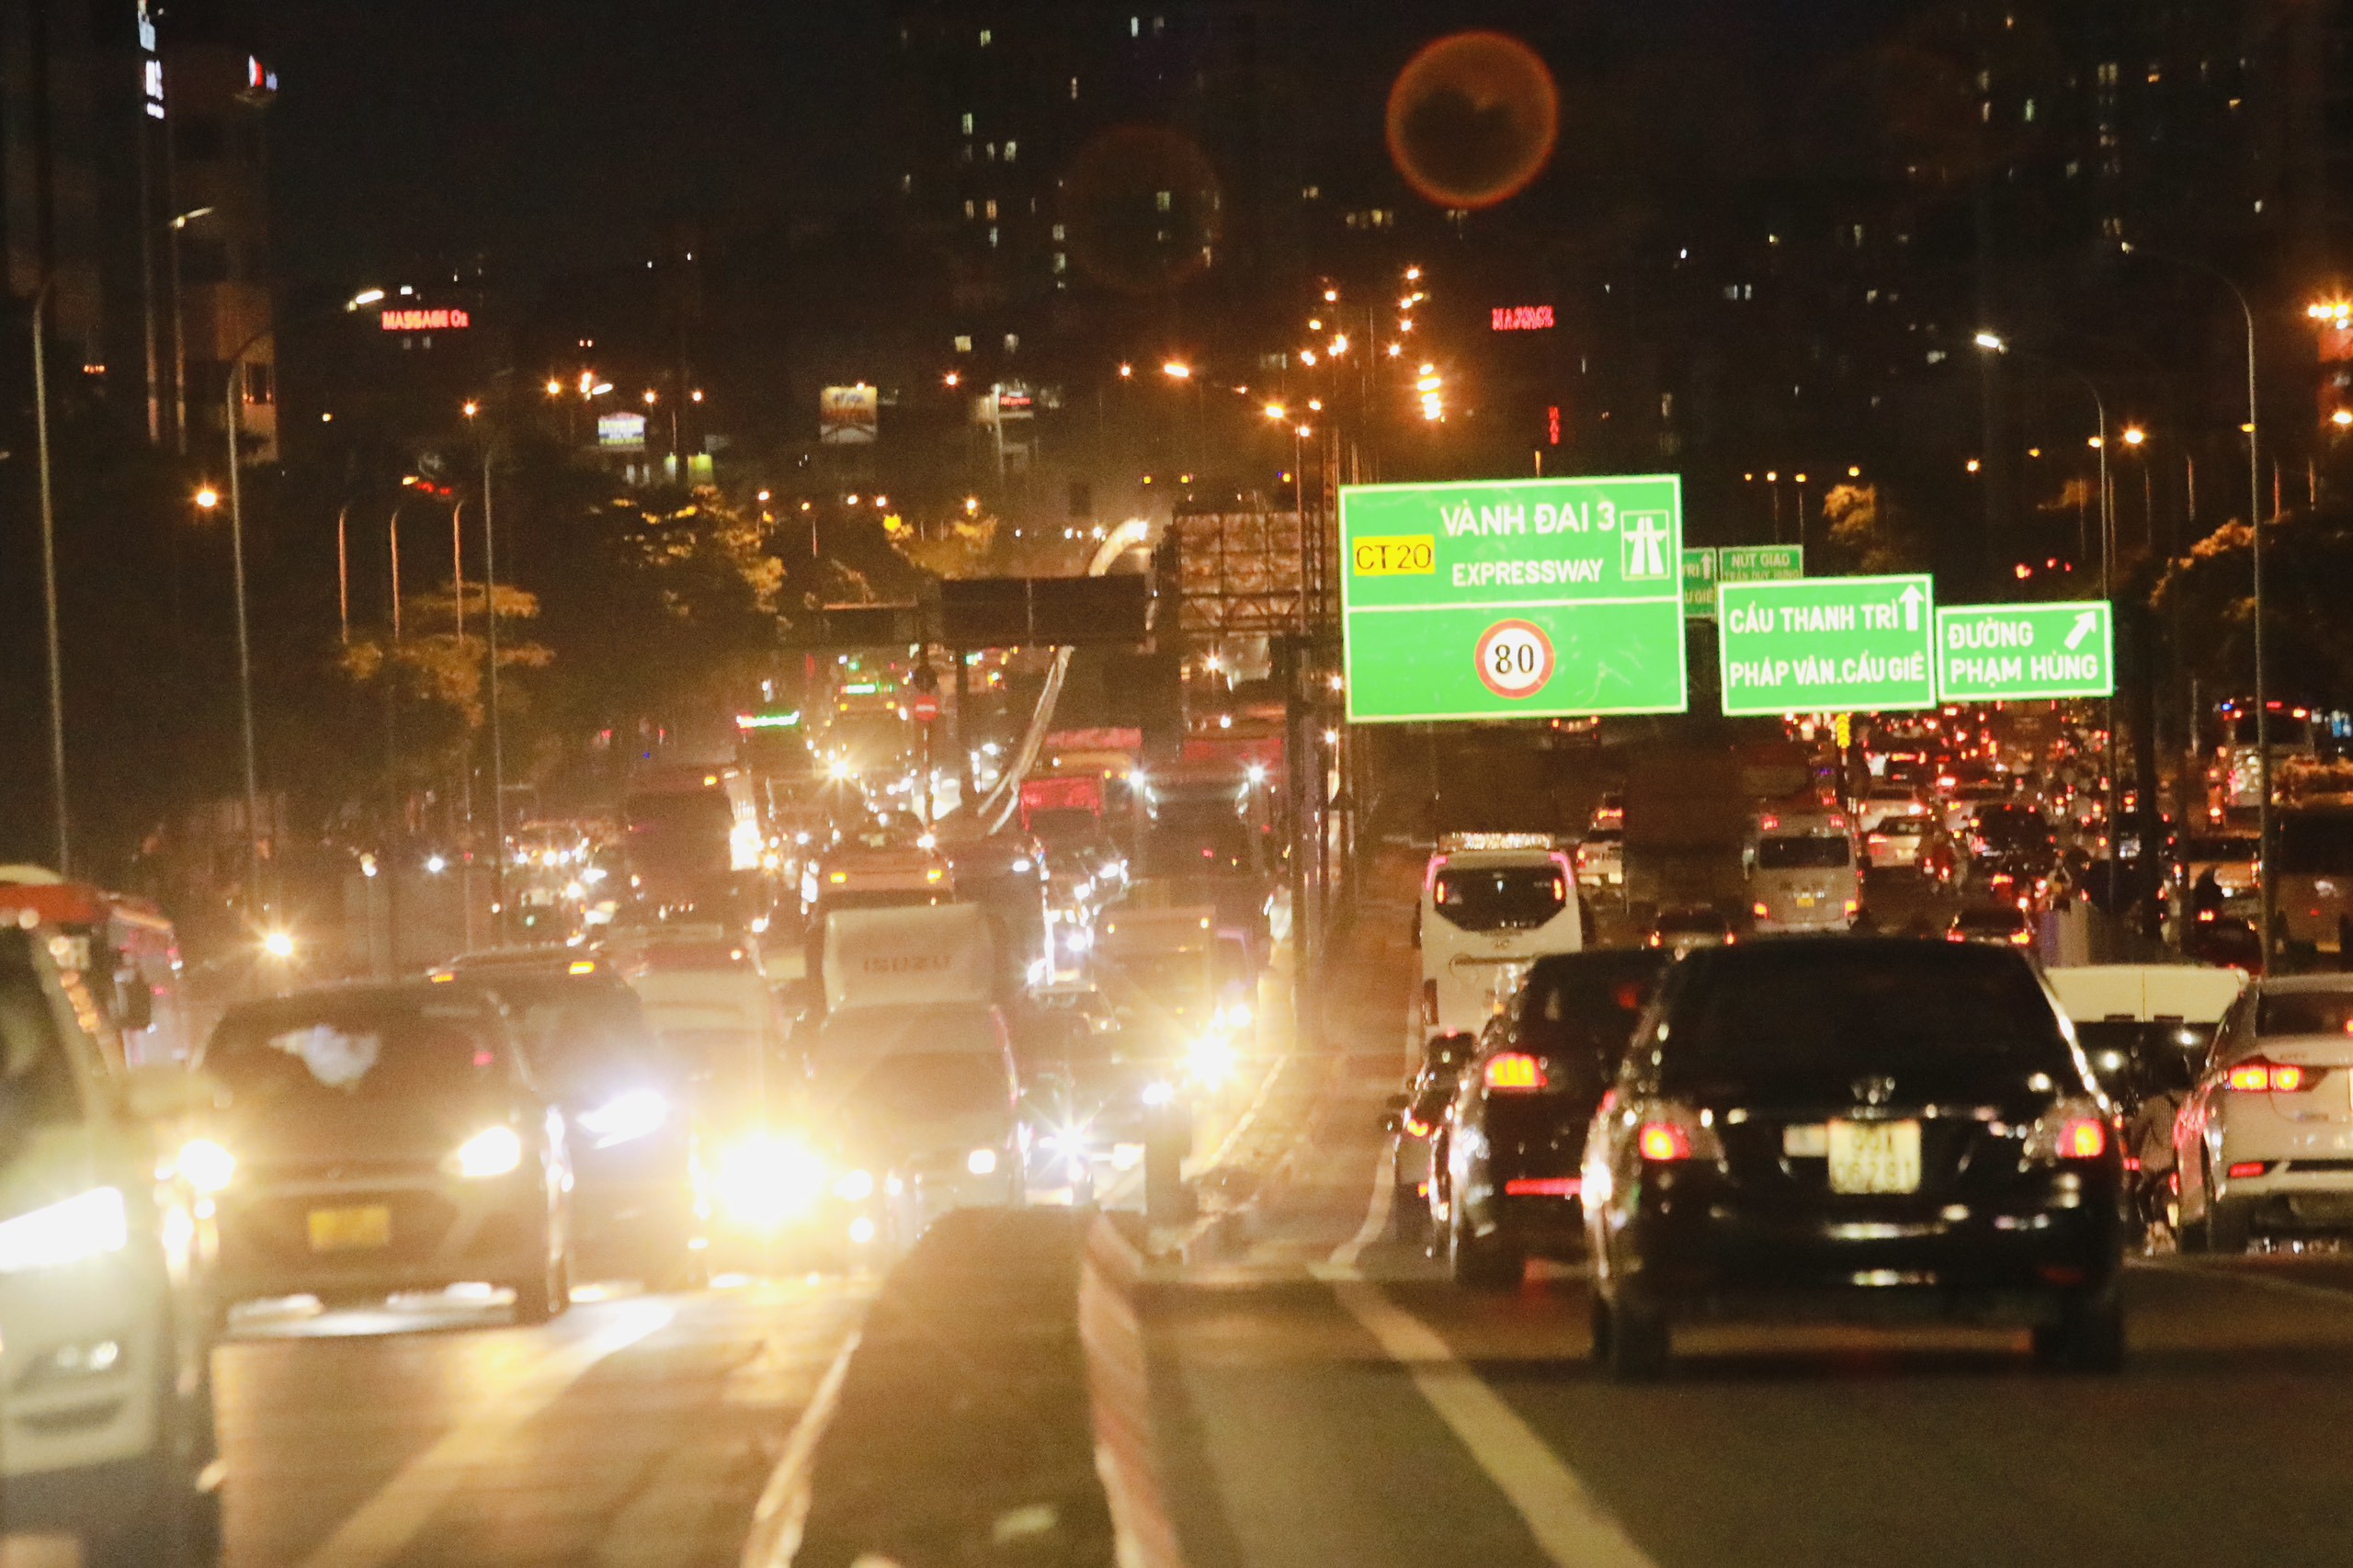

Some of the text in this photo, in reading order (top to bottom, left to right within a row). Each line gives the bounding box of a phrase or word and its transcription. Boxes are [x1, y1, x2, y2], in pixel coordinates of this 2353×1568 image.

[1534, 502, 1590, 535] ĐAI
[1597, 500, 1617, 531] 3
[1451, 558, 1605, 588] EXPRESSWAY
[1779, 604, 1856, 632] THANH
[1493, 642, 1536, 676] 80
[1950, 655, 2022, 688] PHẠM
